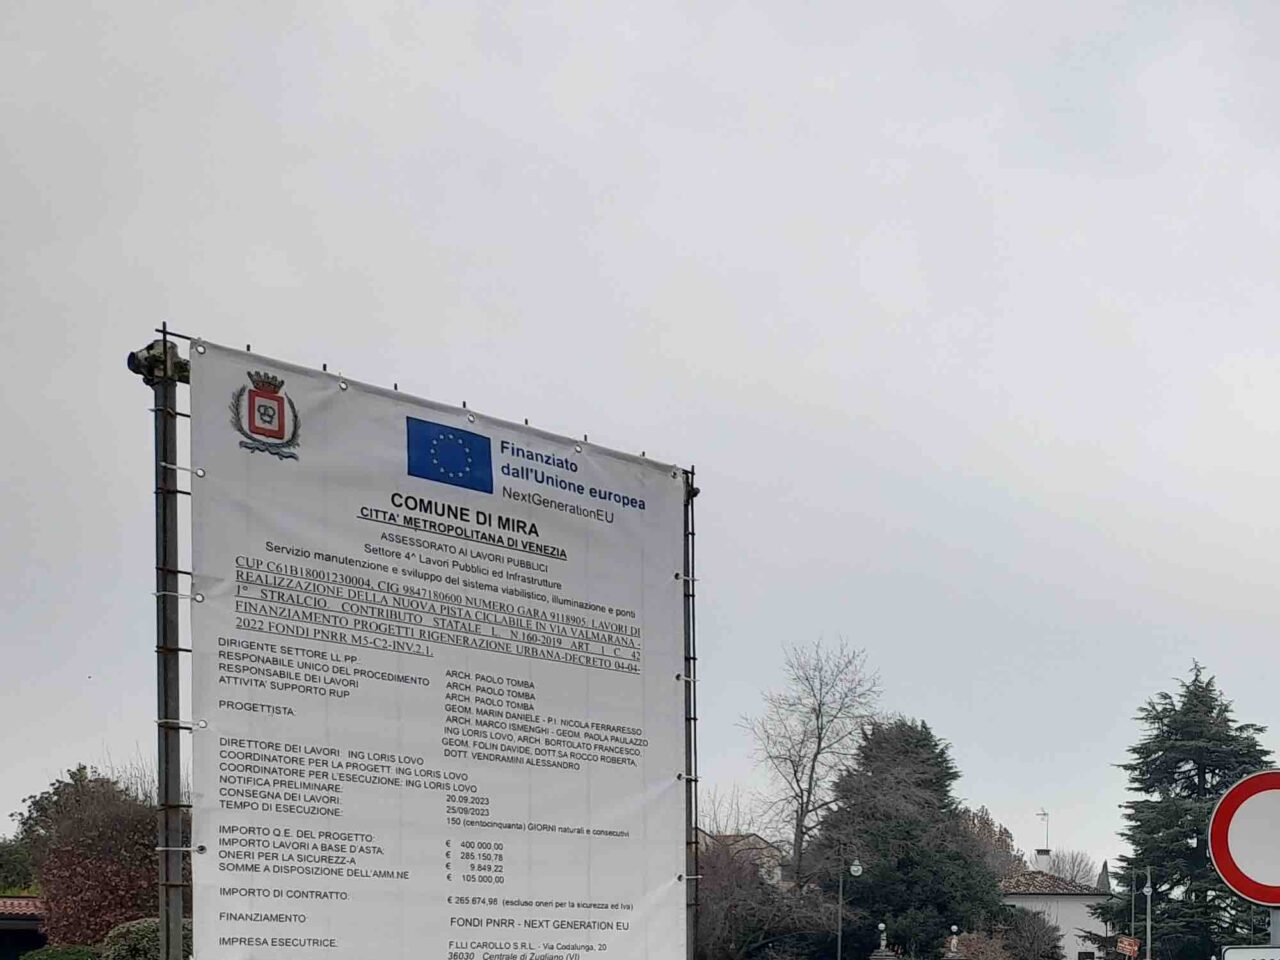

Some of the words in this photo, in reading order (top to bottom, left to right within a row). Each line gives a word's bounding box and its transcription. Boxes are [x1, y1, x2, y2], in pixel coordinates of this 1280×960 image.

[500, 440, 577, 473] Finanziato
[501, 460, 584, 496] dall'Unione
[589, 482, 645, 511] europea
[391, 491, 469, 523] COMUNE
[476, 510, 491, 528] DI
[497, 515, 538, 538] MIRA
[502, 485, 613, 524] NextGenerationEU
[360, 505, 398, 524] CITTA'
[403, 515, 504, 546] METROPOLITANA
[507, 537, 518, 549] DI
[521, 540, 567, 559] VENEZIA
[380, 530, 456, 555] ASSESSORATO
[458, 546, 467, 557] AI
[469, 548, 504, 564] LAVORI
[506, 556, 547, 573] PUBBLICI
[265, 539, 310, 560] Servizio
[314, 549, 388, 575] manutenzione
[401, 565, 442, 585] sviluppo
[444, 573, 460, 588] del
[461, 577, 498, 595] sistema
[551, 594, 605, 615] illuminazione
[615, 606, 635, 621] ponti
[364, 543, 401, 560] Settore
[418, 553, 449, 569] Lavori
[451, 560, 489, 577] Pubblici
[491, 568, 503, 580] ed
[505, 571, 561, 591] Infrastrutture
[235, 555, 263, 569] CUP
[377, 580, 401, 594] CIG
[465, 596, 514, 614] NUMERO
[517, 606, 547, 620] GARA
[591, 619, 627, 634] LAVORI
[630, 626, 640, 636] DI
[235, 568, 343, 597] REALIZZAZIONE
[348, 588, 388, 605] DELLA
[392, 596, 437, 613] NUOVA
[441, 605, 473, 619] PISTA
[474, 610, 532, 629] CICLABILE
[535, 621, 546, 632] IN
[547, 623, 567, 635] VIA
[570, 627, 634, 647] VALMARANA
[235, 616, 264, 630] 2022
[268, 621, 309, 637] FONDI
[313, 628, 346, 643] PNRR
[235, 599, 348, 627] FINANZIAMENTO
[353, 618, 414, 638] PROGETTI
[419, 629, 511, 653] RIGENERAZIONE
[516, 644, 611, 669] URBANA-DECRETO
[218, 636, 276, 653] DIRIGENTE
[280, 645, 327, 660] SETTORE
[218, 649, 294, 668] RESPONABILE
[296, 660, 329, 673] UNICO
[331, 665, 351, 676] DEL
[353, 668, 429, 686] PROCEDIMENTO
[219, 662, 301, 681] RESPONSABILE
[303, 673, 321, 684] DEI
[323, 676, 358, 688] LAVORI
[474, 673, 504, 685] PAOLO
[506, 678, 534, 689] TOMBA
[219, 674, 266, 688] ATTIVITA'
[269, 681, 326, 696] SUPPORTO
[329, 688, 349, 699] RUP
[475, 707, 503, 718] MARIN
[505, 711, 540, 723] DANIELE
[560, 718, 589, 729] NICOLA
[219, 737, 281, 752] DIRETTORE
[284, 743, 301, 754] DEI
[348, 750, 364, 760] ING
[367, 752, 395, 763] LORIS
[398, 755, 423, 766] LOVO
[219, 749, 305, 766] COORDINATORE
[307, 758, 328, 768] PER
[331, 760, 343, 769] LA
[395, 766, 411, 776] ING
[413, 768, 441, 778] LORIS
[443, 771, 468, 781] LOVO
[219, 774, 270, 787] NOTIFICA
[219, 787, 282, 801] CONSEGNA
[283, 792, 301, 802] DEI
[446, 794, 489, 805] 20.09.2023
[218, 824, 270, 836] IMPORTO
[296, 829, 315, 839] DEL
[318, 830, 373, 842] PROGETTO:
[218, 837, 270, 848] IMPORTO
[272, 840, 309, 850] LAVORI
[320, 842, 346, 852] BASE
[218, 862, 260, 872] SOMME
[272, 865, 343, 876] DISPOSIZIONE
[449, 917, 482, 927] FONDI
[485, 917, 514, 928] PNRR
[523, 918, 549, 929] NEXT
[552, 919, 613, 930] GENERATION
[616, 921, 629, 930] EU
